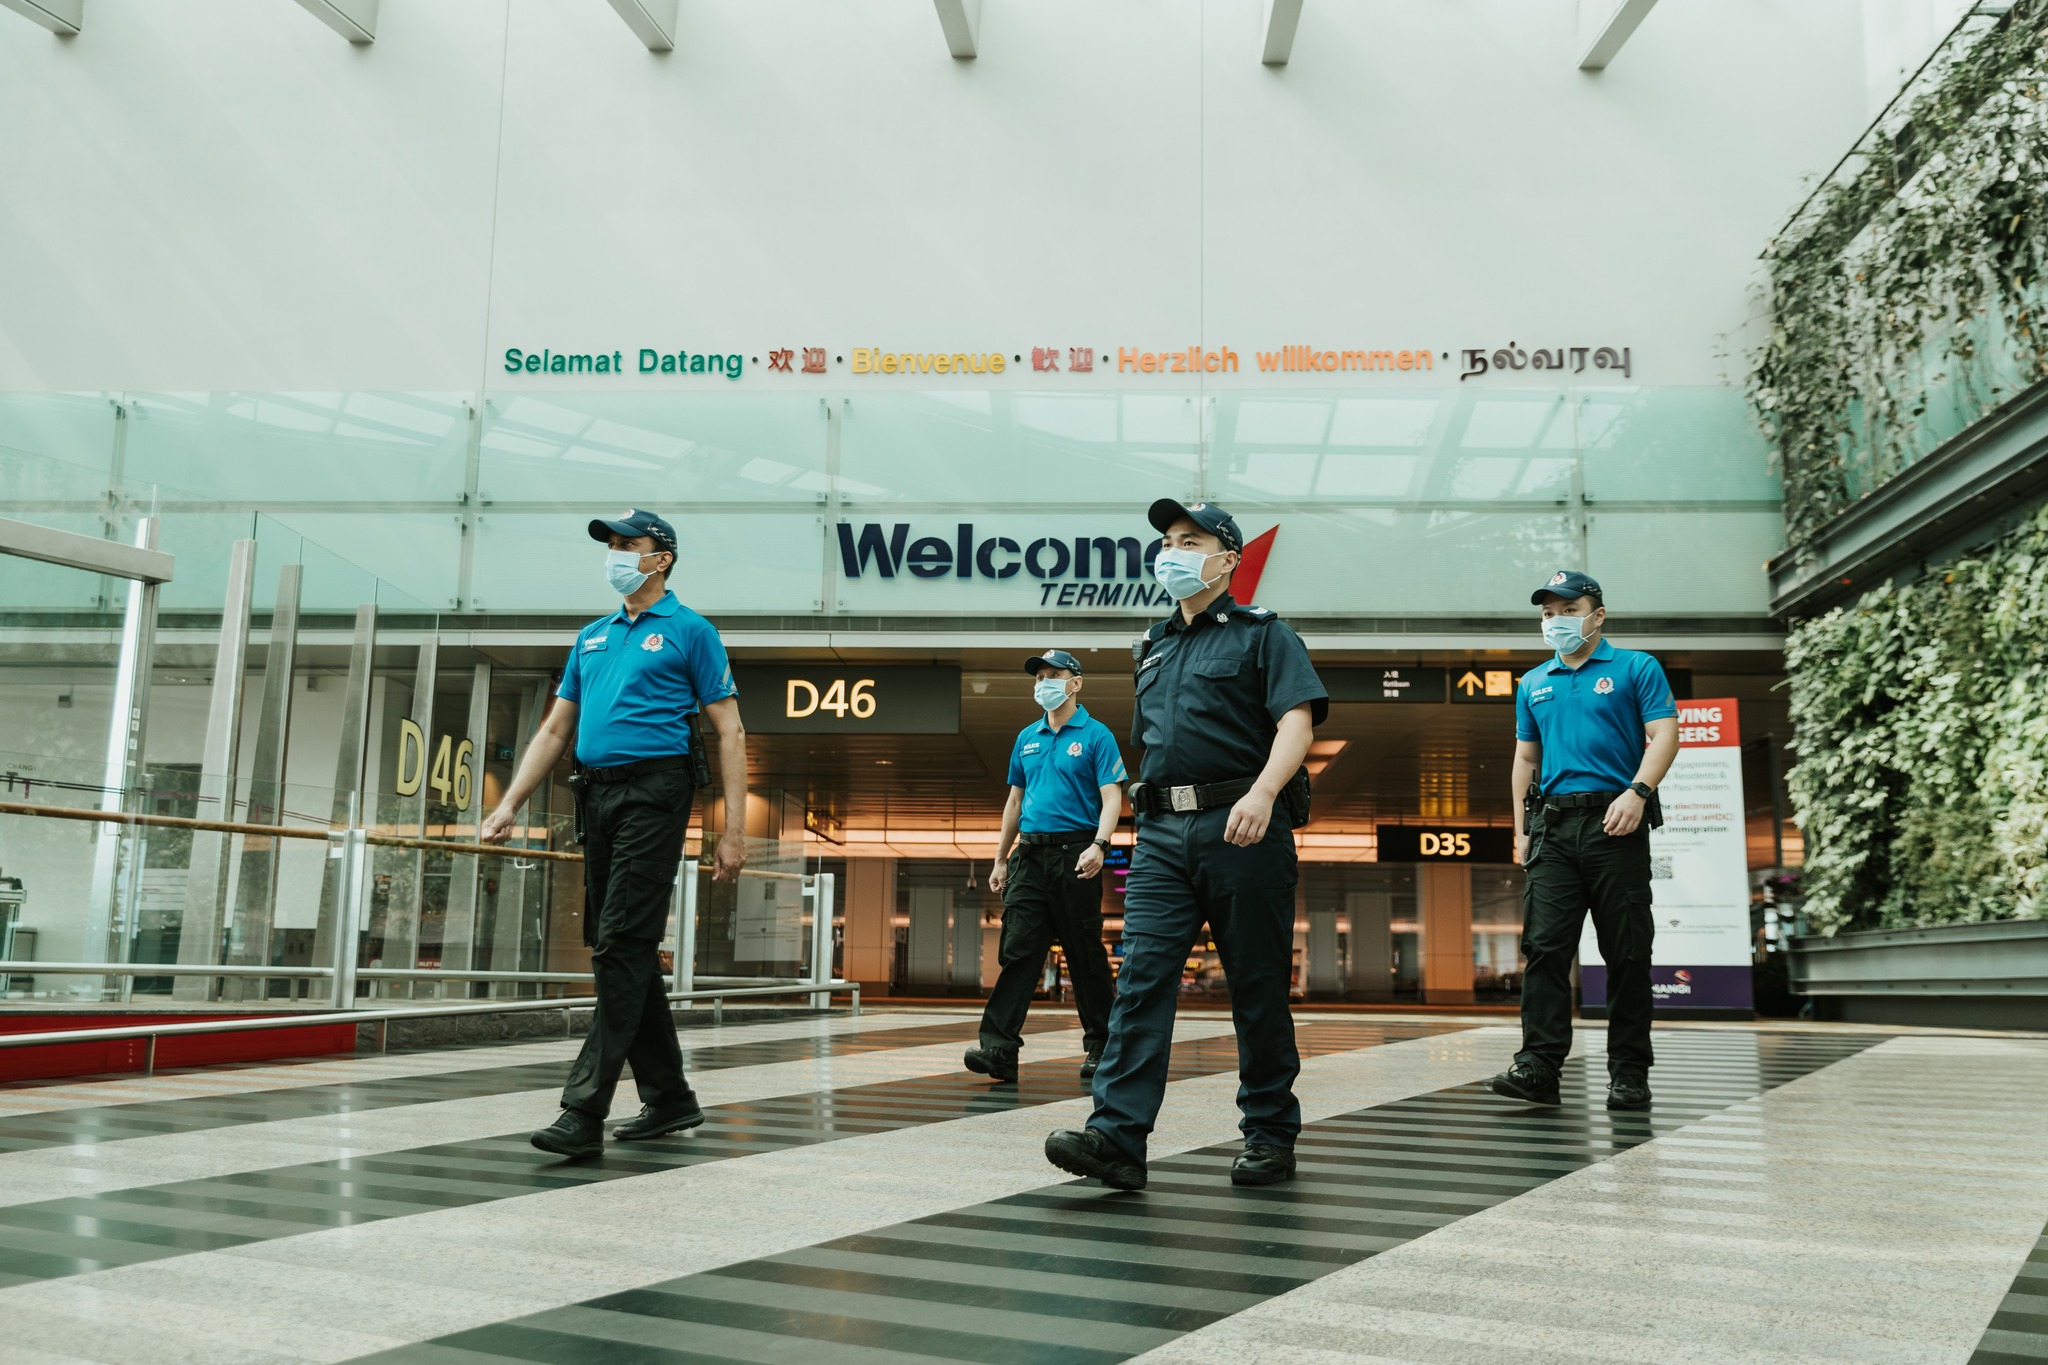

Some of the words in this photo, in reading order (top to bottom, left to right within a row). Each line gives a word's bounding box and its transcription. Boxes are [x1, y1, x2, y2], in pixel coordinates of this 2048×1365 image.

[504, 348, 622, 374] Selamat
[639, 349, 743, 380] Datang
[768, 346, 827, 373] 欢迎
[852, 347, 1006, 373] Bienvenue
[1118, 346, 1239, 373] Herzlich
[1256, 345, 1433, 371] willkommen
[1460, 340, 1630, 381] நல்வரவு
[1040, 583, 1181, 606] TERMINA
[786, 679, 877, 719] D46
[1420, 832, 1471, 856] D35
